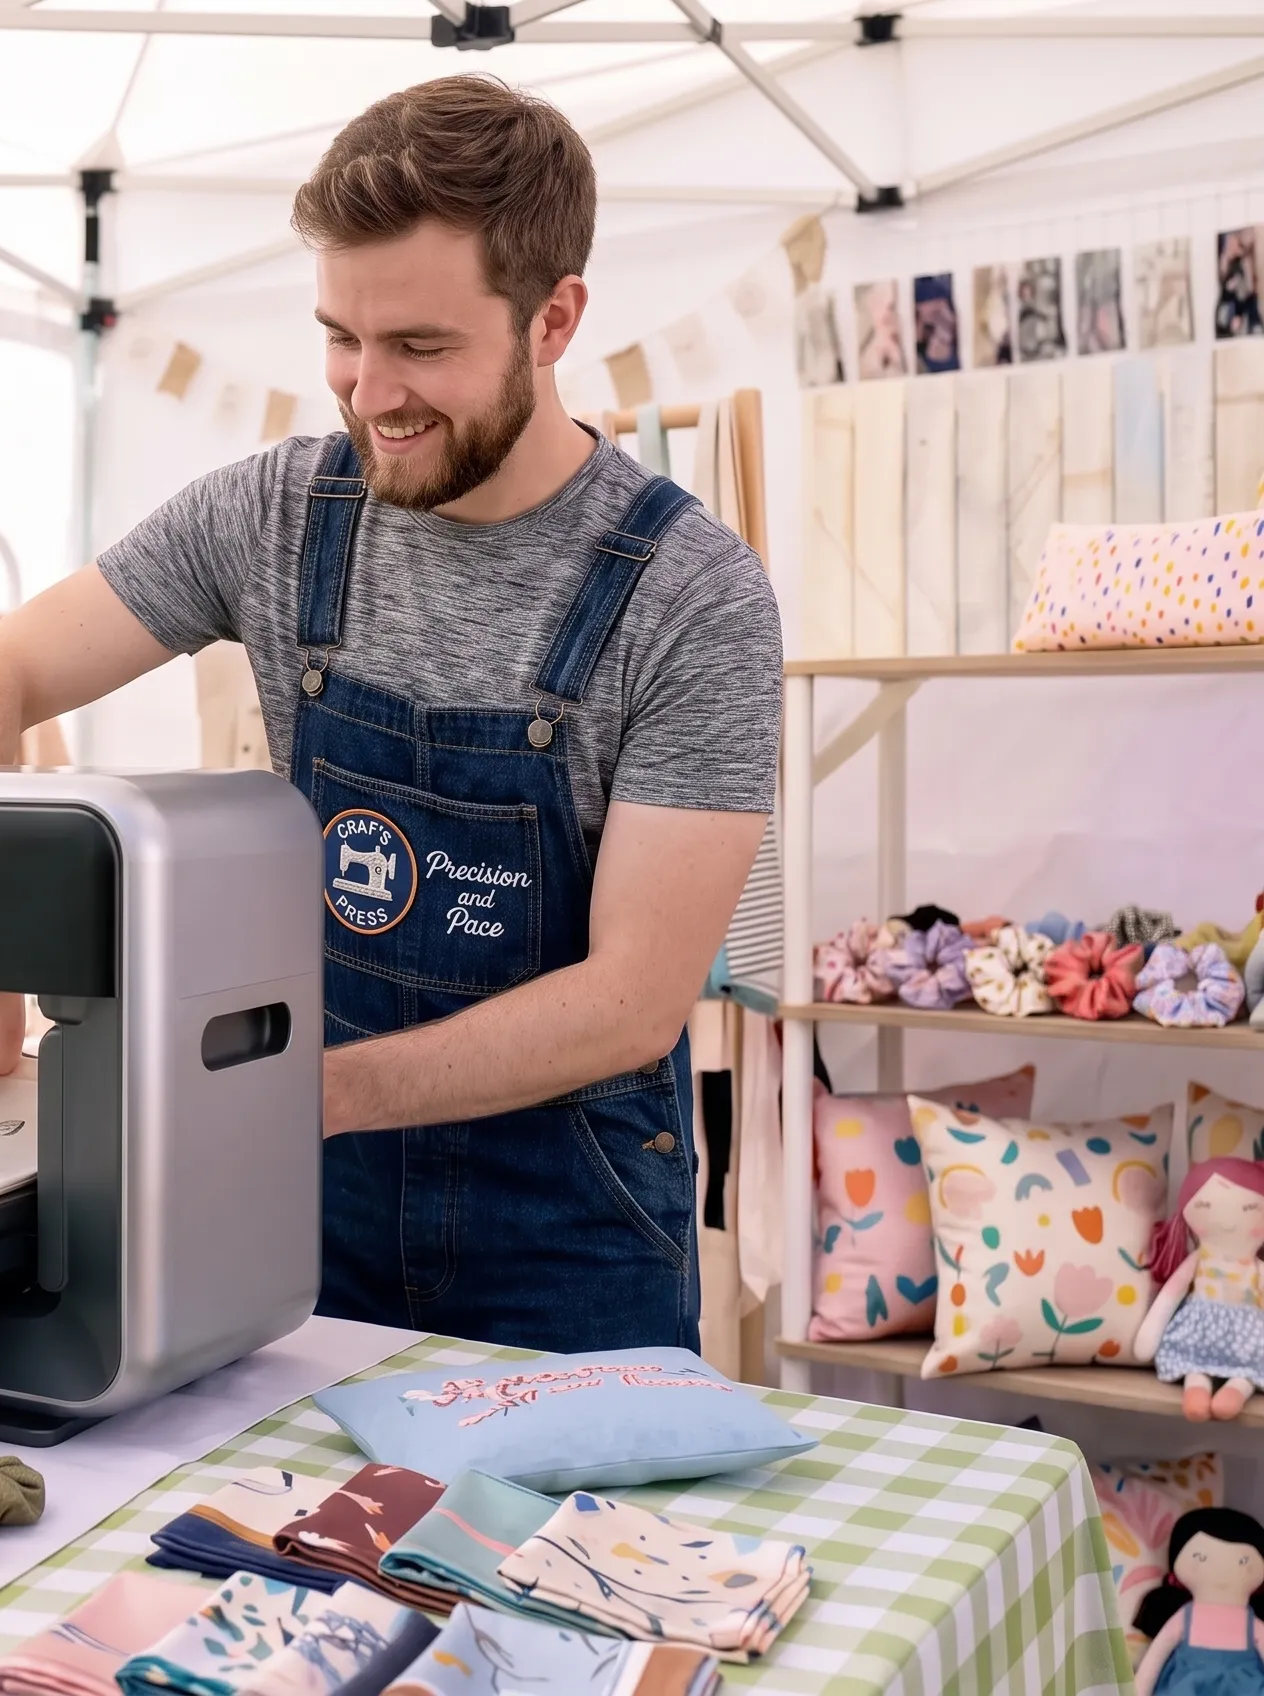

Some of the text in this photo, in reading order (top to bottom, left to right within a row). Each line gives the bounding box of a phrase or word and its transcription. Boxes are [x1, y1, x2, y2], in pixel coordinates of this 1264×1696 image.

[337, 819, 391, 846] CRAF'S
[425, 850, 532, 888] Precision
[336, 896, 388, 926] PRESS
[457, 889, 496, 909] and
[446, 906, 505, 938] Pace
